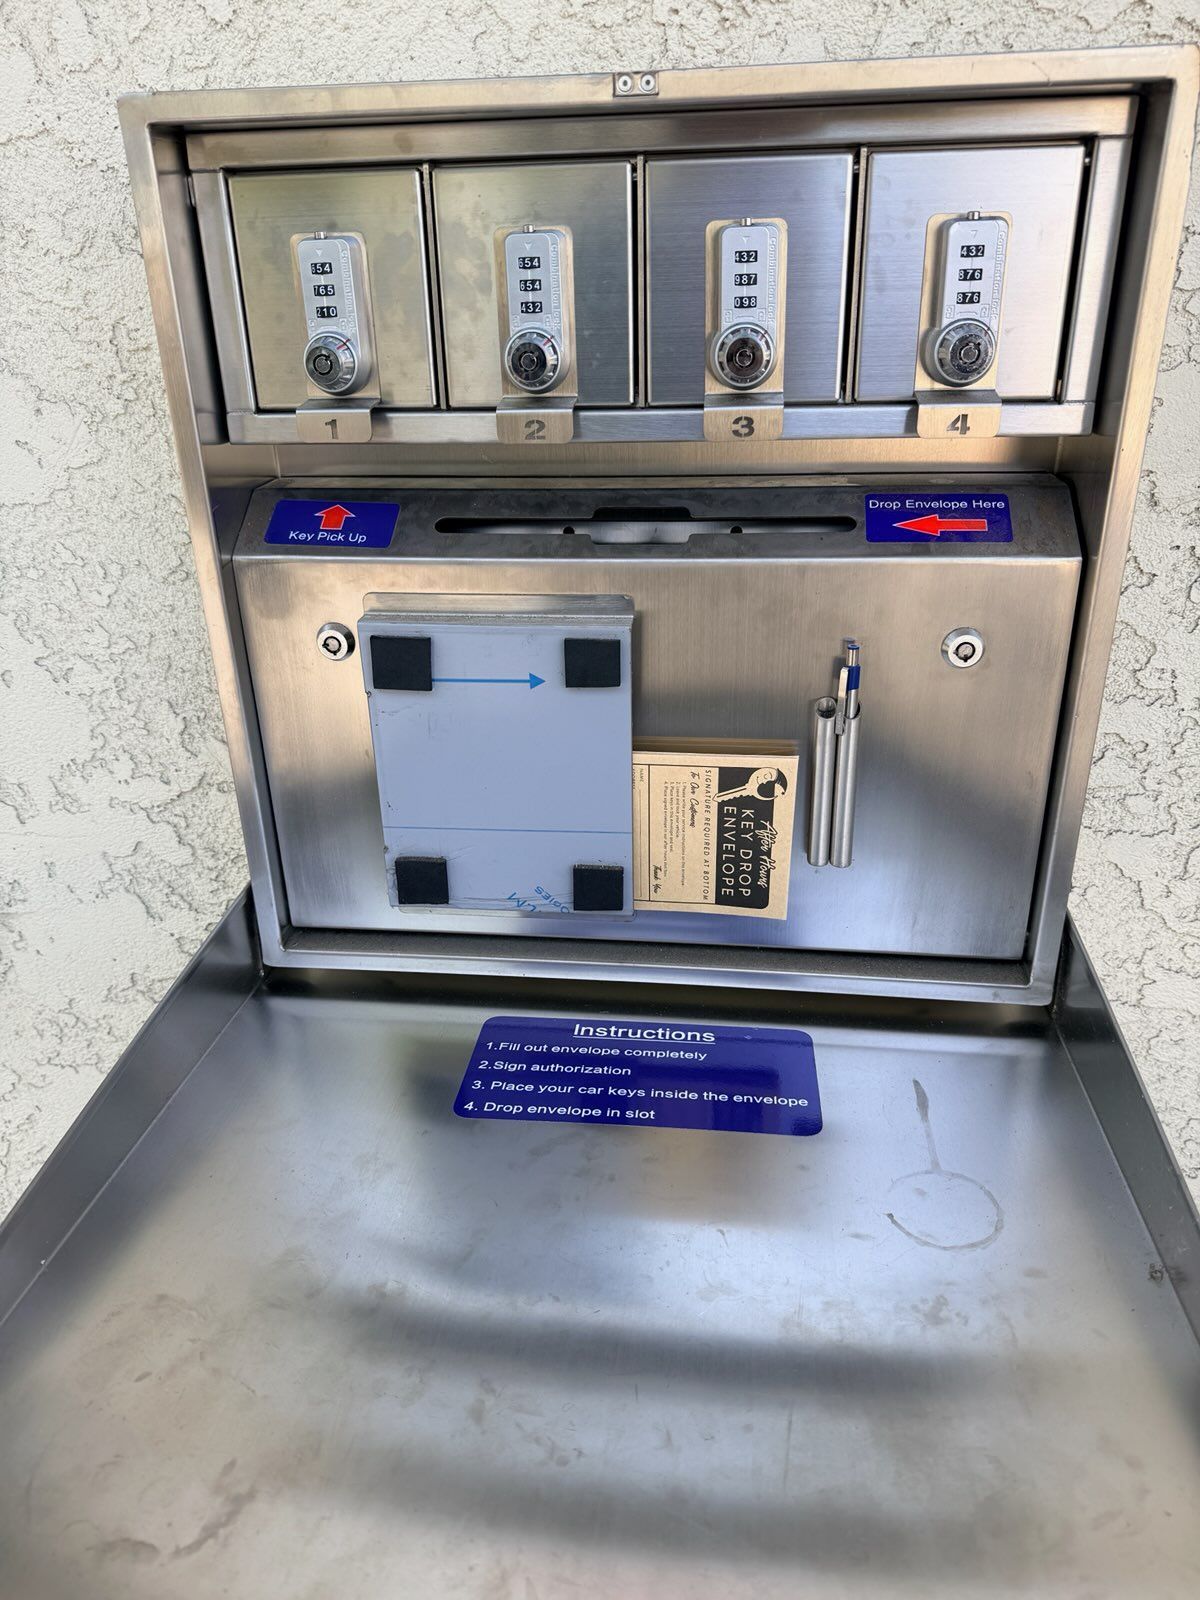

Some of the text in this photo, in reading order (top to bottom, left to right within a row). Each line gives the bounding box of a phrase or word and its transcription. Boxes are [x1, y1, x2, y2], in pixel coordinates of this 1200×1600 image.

[734, 297, 757, 307] 098
[324, 418, 339, 440] 1
[524, 419, 546, 440] 2
[731, 415, 755, 437] 3
[946, 413, 971, 435] 4
[869, 500, 1005, 510] Drop Envelope Here
[288, 531, 367, 544] Key Pick Up
[688, 771, 700, 828] To Our Customers
[702, 769, 712, 900] SIGNATURE REQUIRED AT BOTTOM
[721, 806, 737, 896] ENVELOPE
[738, 809, 755, 897] KEY DROP
[755, 820, 778, 888] After Hours
[652, 864, 662, 880] Thank
[573, 1023, 716, 1043] Instructions
[523, 1043, 548, 1053] out
[551, 1044, 621, 1057] envelope
[623, 1047, 708, 1061] completely
[530, 1062, 632, 1076] authorization
[471, 1080, 809, 1108] 3. Place your car keys inside the envelope
[464, 1101, 656, 1120] 4. Drop envelope in slot
